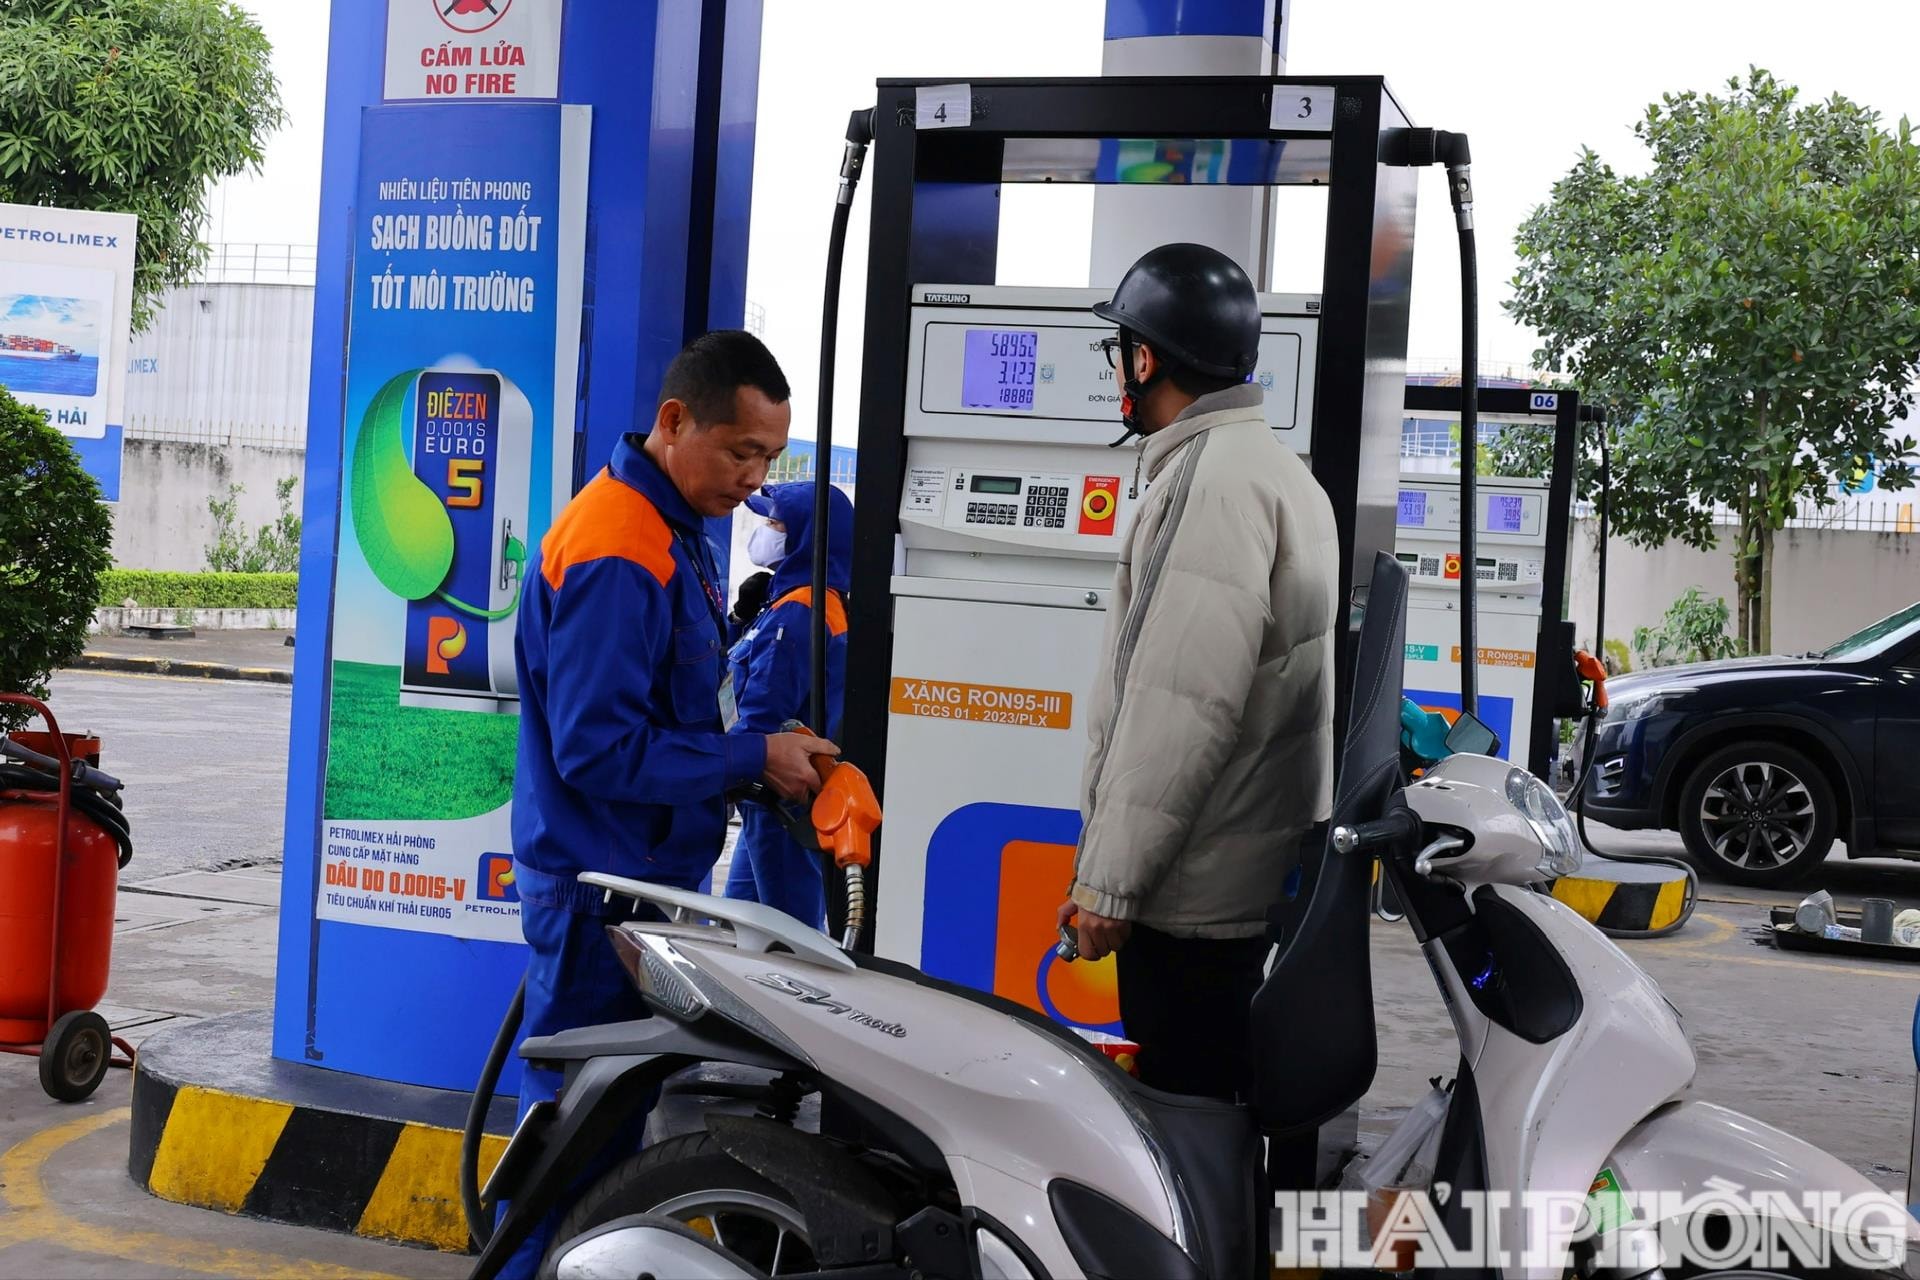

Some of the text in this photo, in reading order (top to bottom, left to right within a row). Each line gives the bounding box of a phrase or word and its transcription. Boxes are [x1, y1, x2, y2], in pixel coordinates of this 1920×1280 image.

[420, 40, 526, 67] CẤM LỬA
[425, 73, 516, 94] NO FIRE
[934, 102, 947, 123] 4
[1297, 96, 1312, 118] 3
[379, 177, 531, 203] NHIÊN LIỆU TIÊN PHONG
[371, 203, 542, 256] SẠCH BUỒNG ĐỐT
[371, 263, 534, 313] TỐT MÔI TRƯỜNG
[926, 293, 969, 304] TATSUNO
[1099, 369, 1114, 380] LÍT
[427, 387, 487, 420] ĐIÊZEN
[1534, 395, 1555, 408] 06
[58, 406, 88, 425] HẢI
[425, 437, 485, 455] EURO
[446, 458, 484, 507] 5
[902, 680, 1061, 713] XĂNG RON95-III
[912, 703, 950, 717] TCCS
[954, 707, 969, 720] 01
[983, 710, 1048, 727] 2023/PLX
[329, 827, 436, 850] PETROLIMEX HẢI PHÒNG
[328, 844, 420, 866] CUNG CẤP MẶT HÀNG
[326, 860, 358, 888] DẦU
[362, 868, 384, 892] DO
[326, 893, 452, 919] TIÊU CHUẨN KHÍ THẢI EURO5
[465, 904, 520, 916] PETROLIM
[848, 1009, 906, 1038] mode
